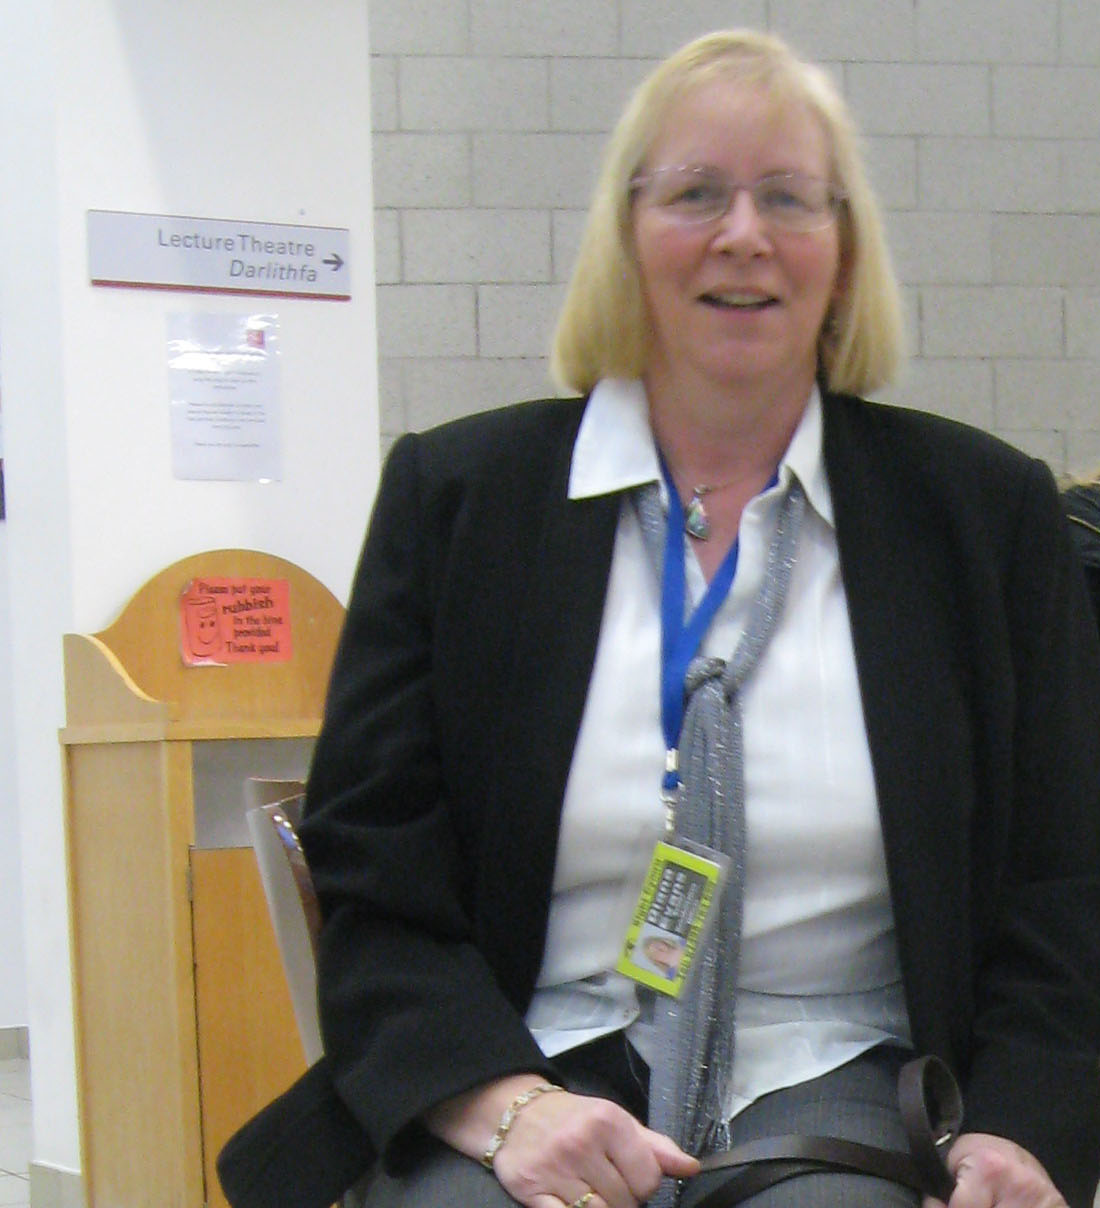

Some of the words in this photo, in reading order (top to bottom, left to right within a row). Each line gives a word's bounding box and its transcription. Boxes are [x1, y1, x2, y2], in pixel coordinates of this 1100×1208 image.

[159, 229, 235, 251] Lecture
[238, 234, 315, 256] Theatre
[230, 259, 318, 282] Darlithfa
[231, 584, 247, 596] put
[222, 597, 273, 614] rubbish
[233, 627, 271, 638] provided
[225, 641, 256, 653] Thank
